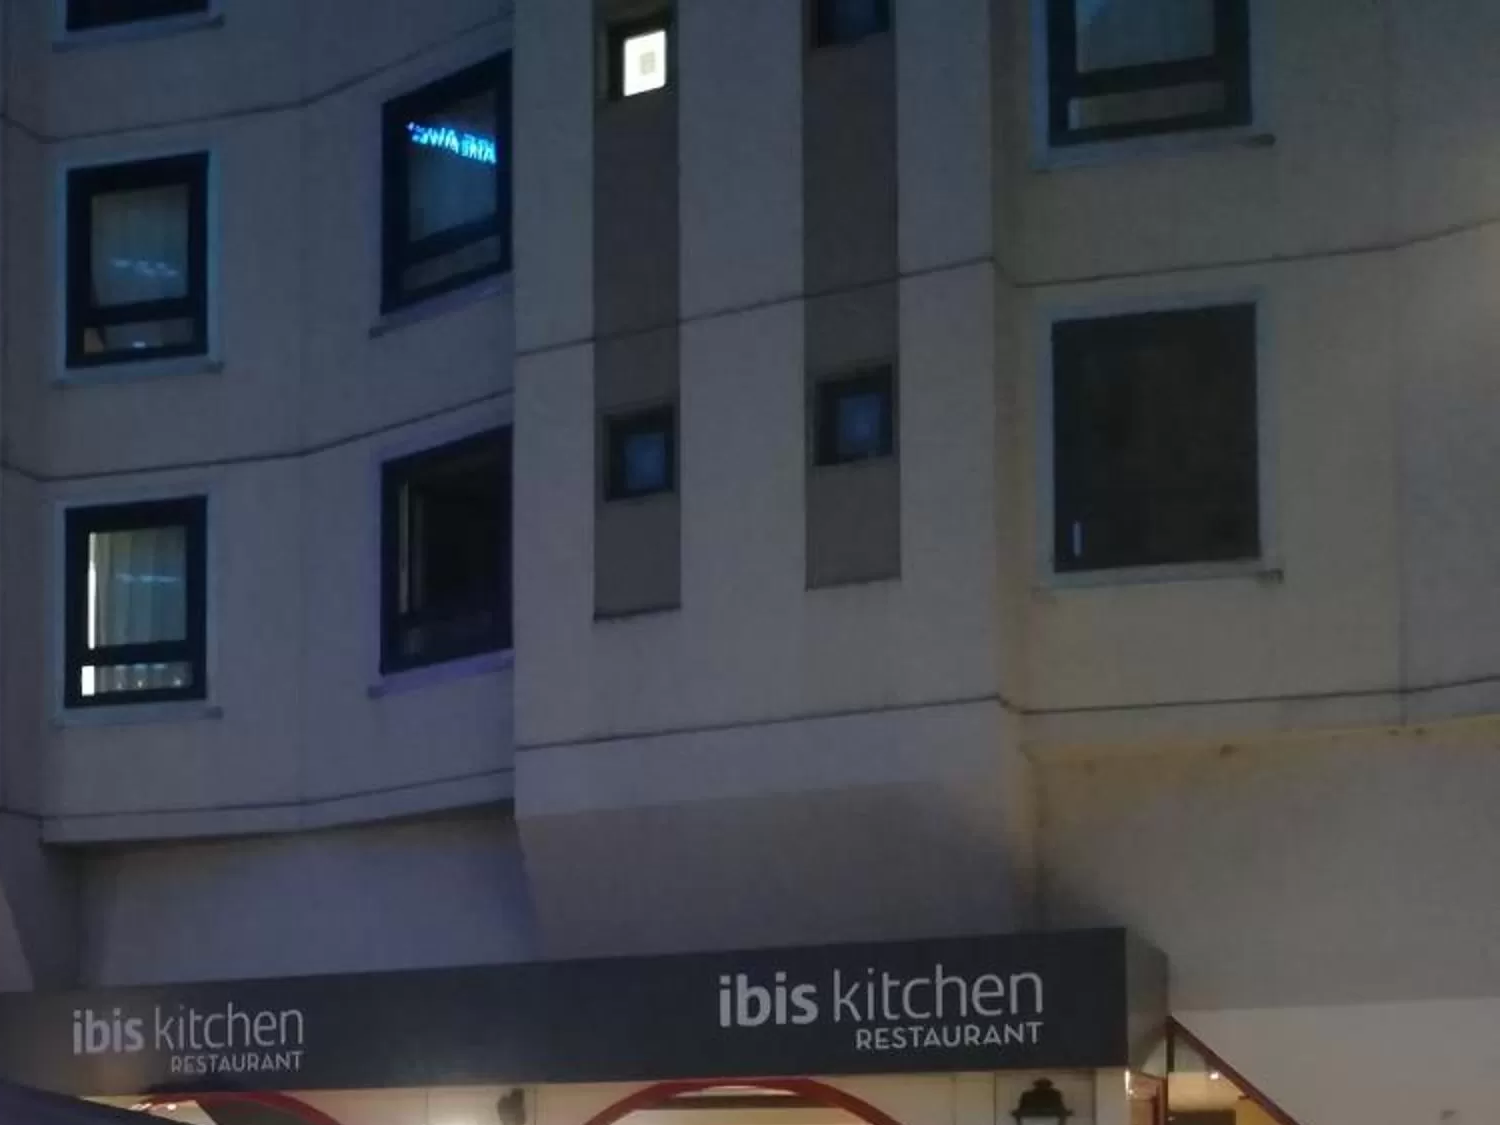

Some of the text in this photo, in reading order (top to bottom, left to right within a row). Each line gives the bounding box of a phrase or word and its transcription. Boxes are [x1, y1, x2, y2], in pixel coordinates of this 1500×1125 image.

[718, 963, 1044, 1028] ibis kitchen
[72, 1001, 305, 1056] ibis kitchen
[855, 1021, 1044, 1051] RESTAURANT
[171, 1050, 304, 1074] RESTAURANT
